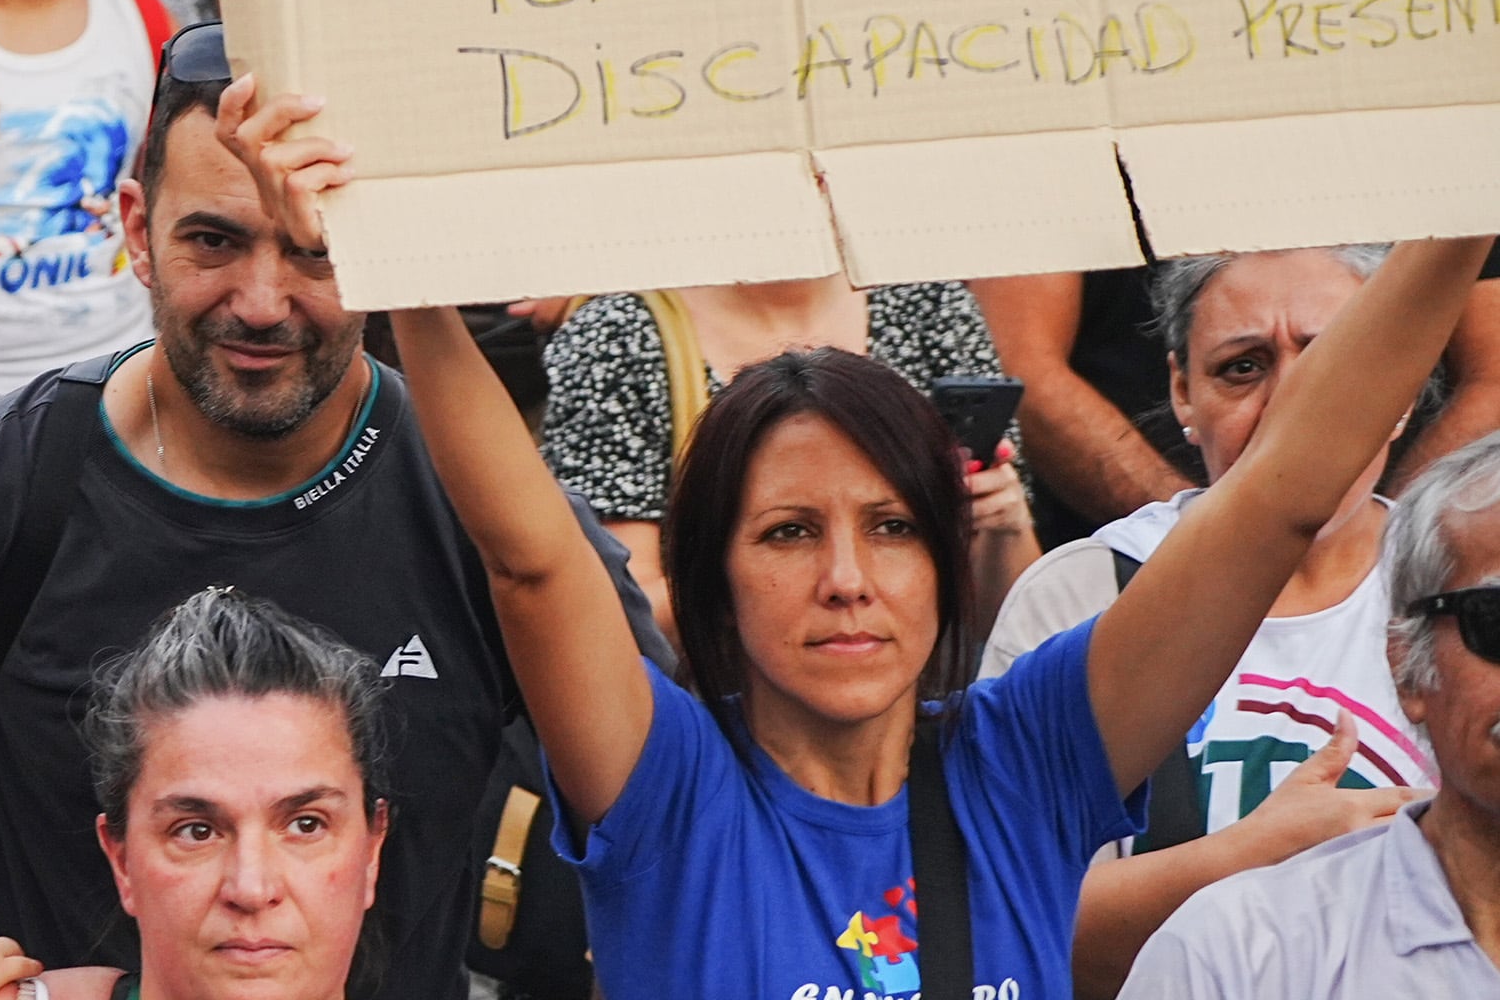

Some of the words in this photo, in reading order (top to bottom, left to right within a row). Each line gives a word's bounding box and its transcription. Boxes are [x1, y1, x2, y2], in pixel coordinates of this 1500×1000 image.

[457, 2, 1198, 140] DISCAPACIDAD
[294, 471, 347, 510] BIELLA
[342, 427, 381, 474] ITALIA
